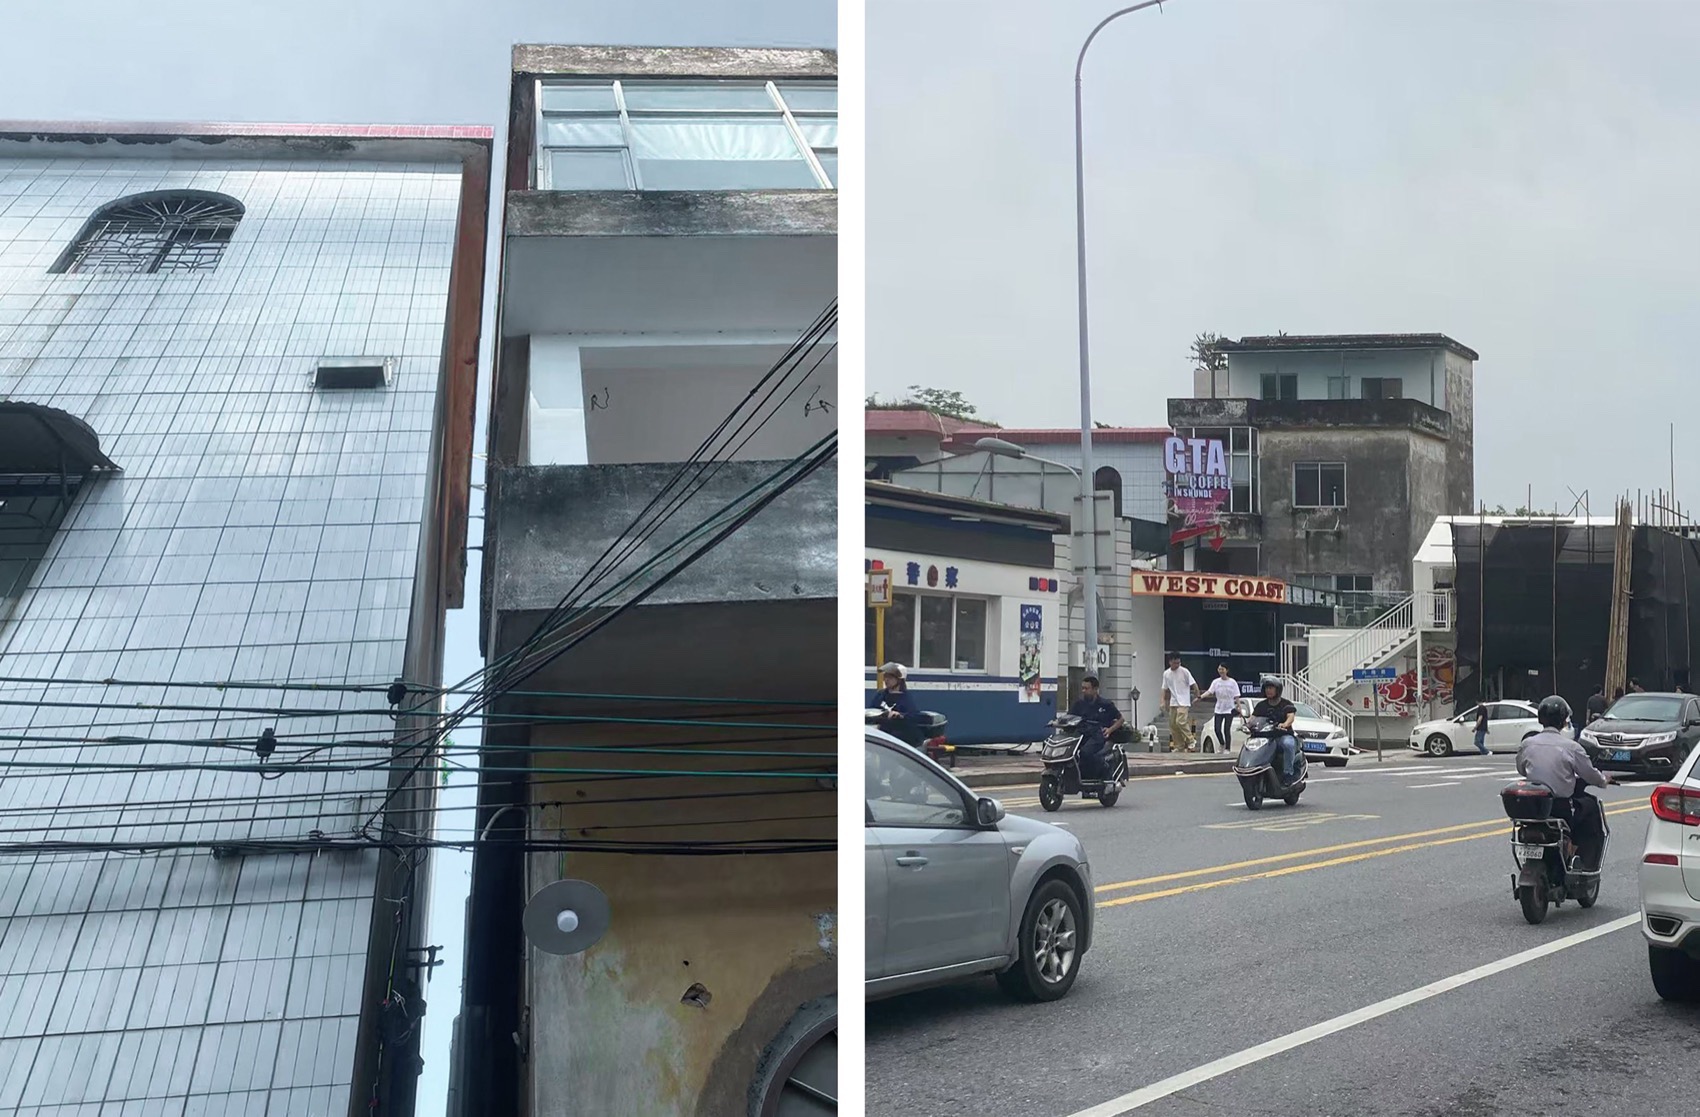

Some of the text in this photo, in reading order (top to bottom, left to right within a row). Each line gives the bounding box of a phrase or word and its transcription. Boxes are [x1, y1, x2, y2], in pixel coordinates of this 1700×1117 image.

[1165, 436, 1227, 476] GTA
[1183, 488, 1213, 498] SHUNDE
[1142, 575, 1284, 599] WEST COAST
[1242, 685, 1253, 693] GTA
